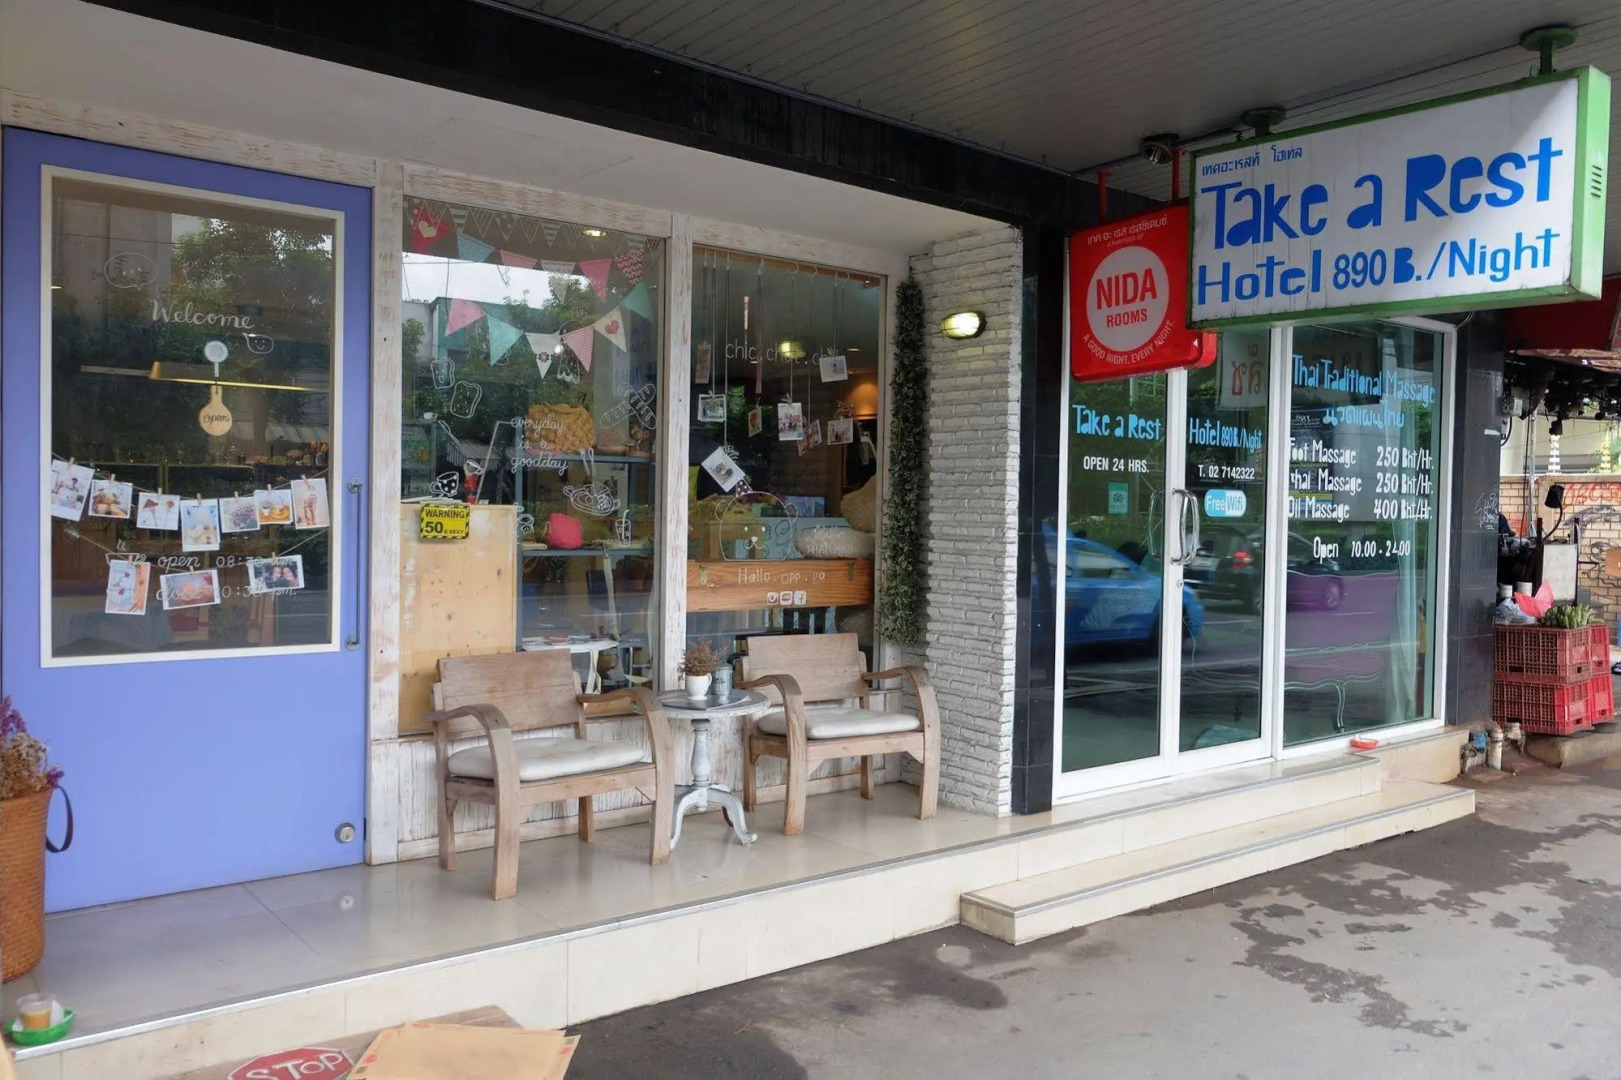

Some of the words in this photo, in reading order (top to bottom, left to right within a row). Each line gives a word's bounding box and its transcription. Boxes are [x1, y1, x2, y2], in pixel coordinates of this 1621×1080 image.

[1201, 181, 1329, 250] Take
[1346, 174, 1383, 229] a
[1404, 137, 1563, 222] Rest
[1096, 268, 1158, 310] NIDA
[1197, 249, 1321, 305] Hotel
[1332, 248, 1387, 290] 890
[151, 299, 254, 329] Welcome
[1106, 308, 1148, 328] ROOMS
[726, 338, 756, 360] chic
[1087, 340, 1106, 359] GOOD
[1106, 353, 1130, 365] NIGHT.
[1131, 343, 1155, 363] EVERY
[1154, 319, 1175, 348] NIGHT.
[1292, 354, 1319, 388] Thai
[1320, 359, 1382, 396] Traditional
[1385, 369, 1436, 407] Massage
[511, 414, 567, 437] everyday
[1072, 404, 1111, 436] Take
[1114, 416, 1124, 437] a
[1128, 414, 1162, 440] Rest
[1189, 418, 1220, 446] Hotel
[540, 440, 550, 450] a
[1289, 437, 1308, 461] Foot
[1312, 440, 1357, 468] Massage
[1376, 446, 1400, 467] 250
[1083, 456, 1109, 471] OPEN
[1112, 458, 1125, 472] 24
[1128, 459, 1150, 473] HRS.
[1198, 464, 1206, 478] T.
[1208, 465, 1219, 478] 02
[1221, 466, 1256, 480] 7142322
[1318, 468, 1362, 496] Massage
[1375, 473, 1399, 494] 250
[425, 510, 465, 519] WARNING
[1288, 496, 1300, 518] Oil
[1304, 496, 1350, 523] Massage
[1373, 499, 1398, 520] 400
[425, 521, 444, 534] 50
[1313, 536, 1339, 564] Open
[1351, 541, 1377, 557] 10.00
[157, 555, 201, 574] open
